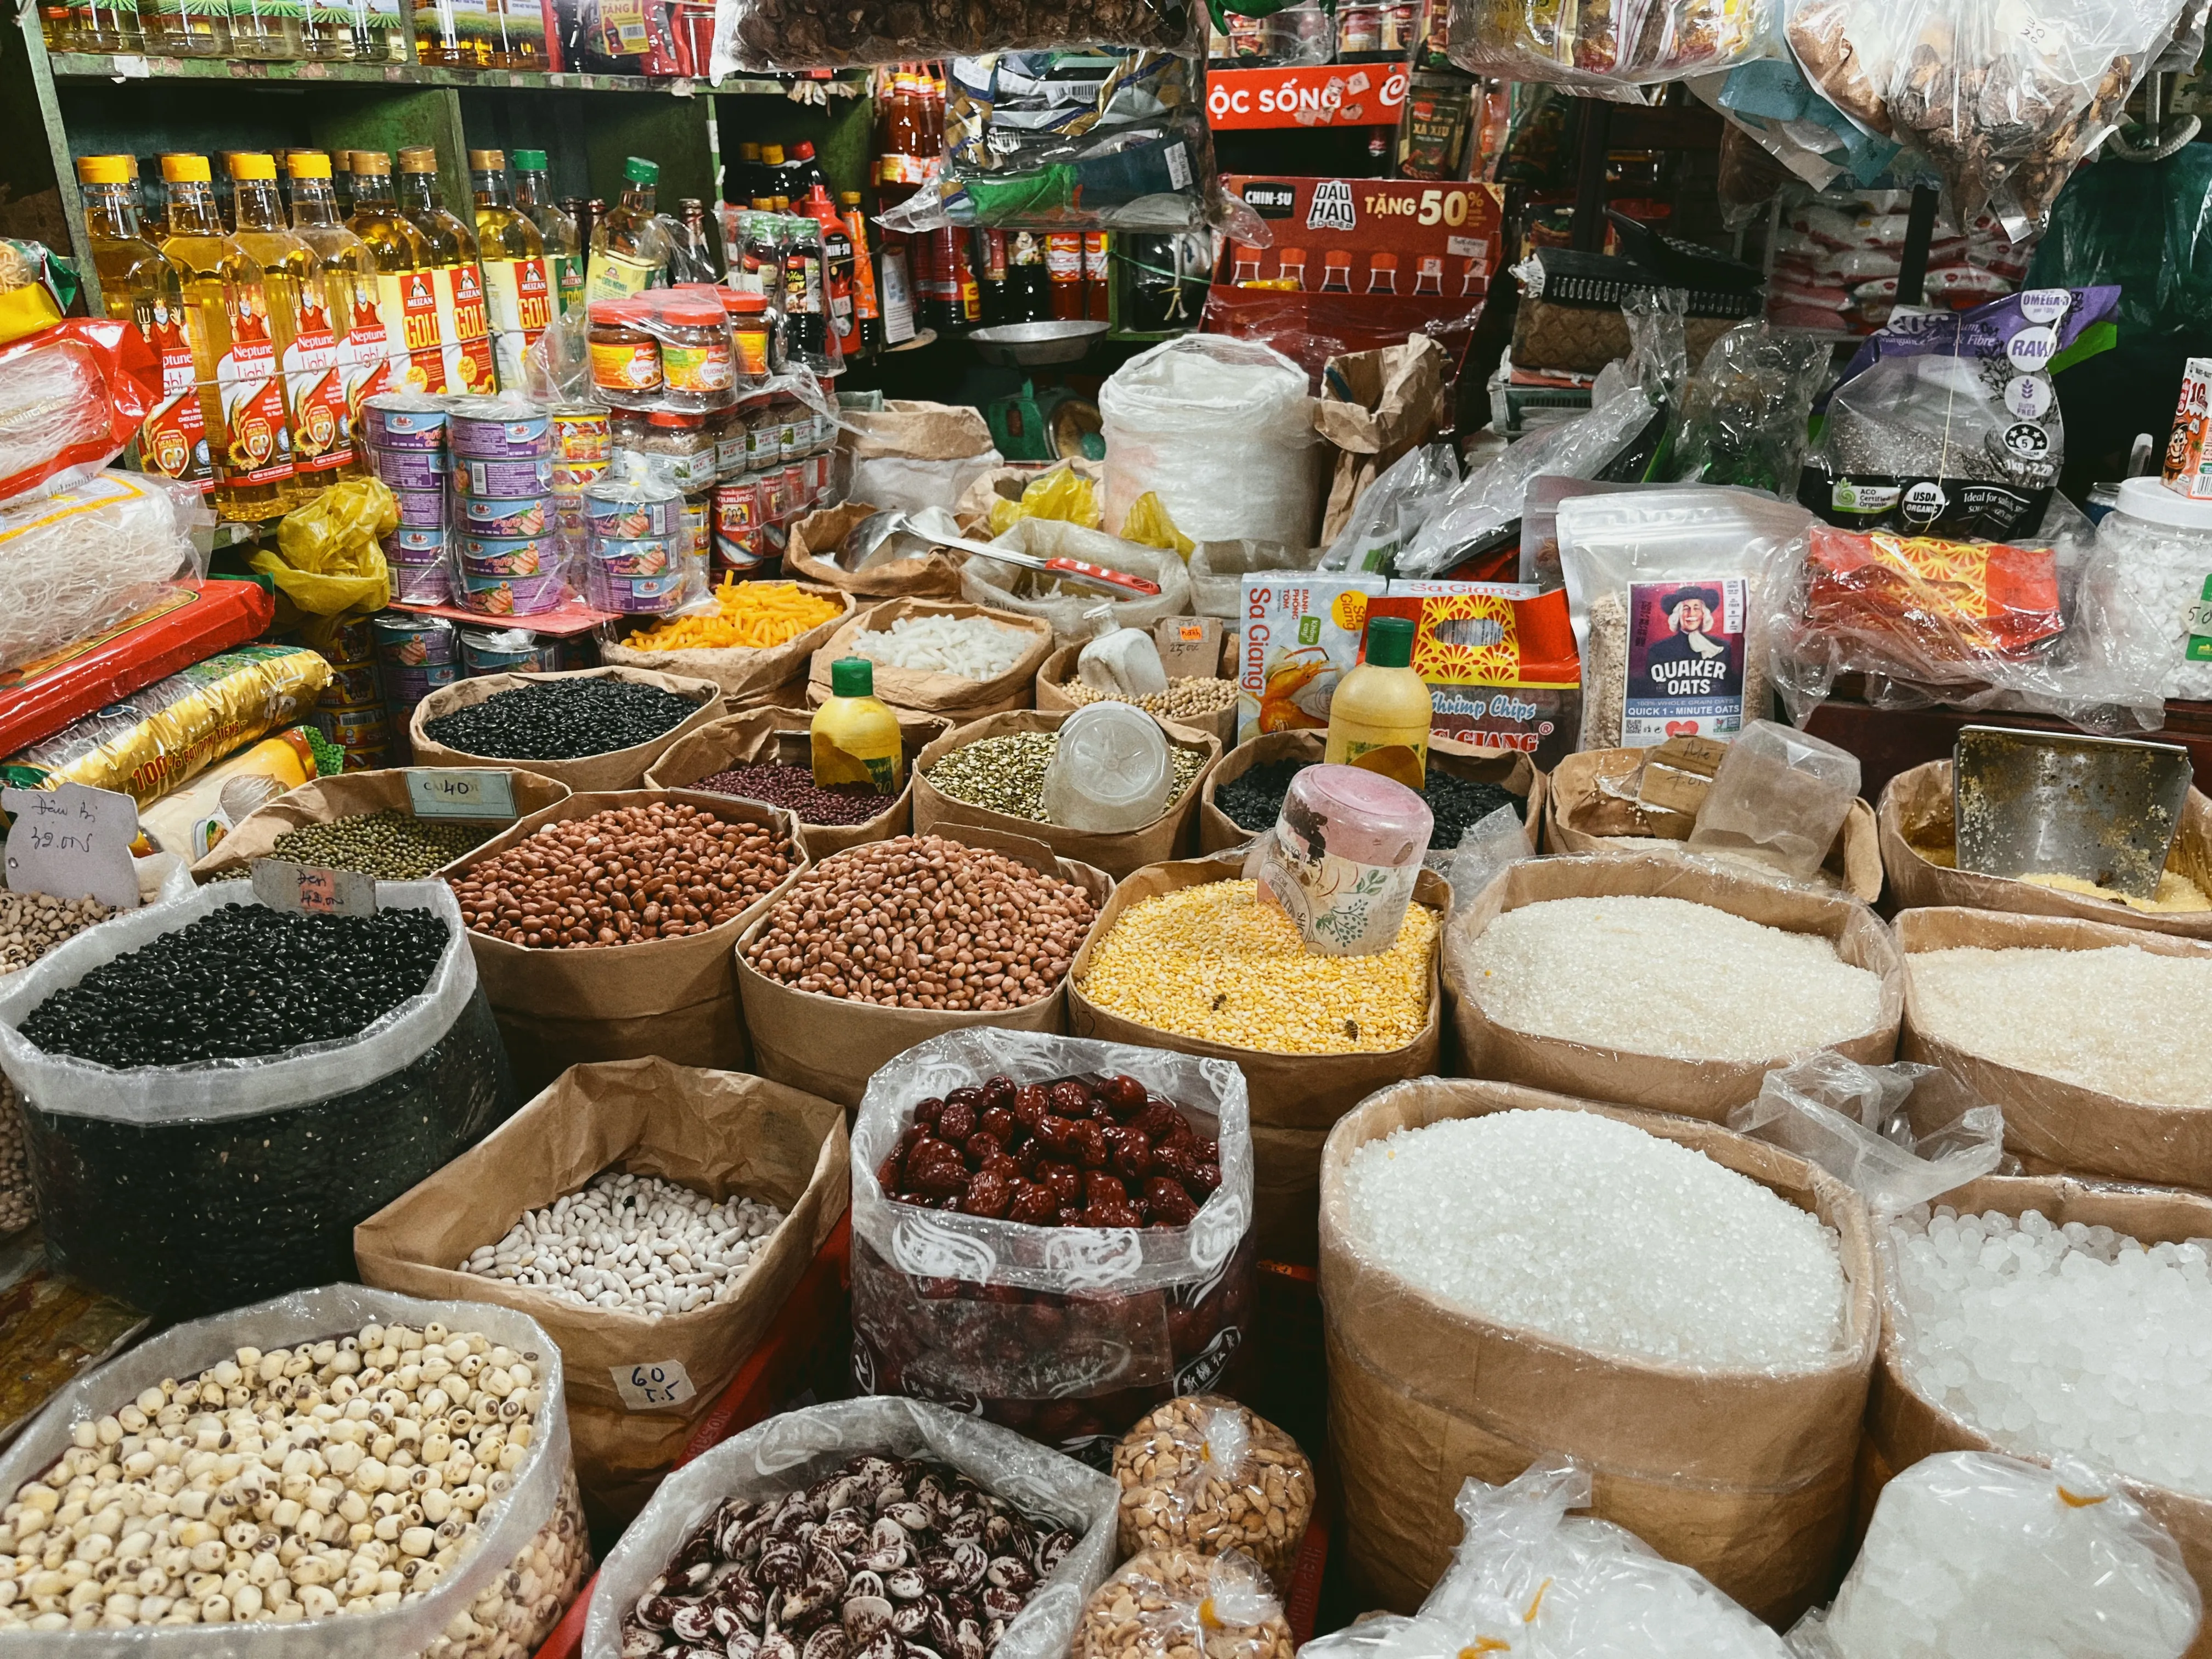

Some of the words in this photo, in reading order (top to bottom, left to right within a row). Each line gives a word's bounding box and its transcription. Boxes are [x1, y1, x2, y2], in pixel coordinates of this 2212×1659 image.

[1259, 78, 1342, 113] SỐNG
[1244, 190, 1293, 206] CHIN-SU
[1364, 193, 1417, 219] TẶNG
[1311, 198, 1353, 221] HÀO
[457, 288, 481, 300] MEIZAN
[521, 281, 546, 292] MEIZAN
[407, 296, 433, 308] MEIZAN
[297, 335, 334, 349] Neptune
[351, 329, 386, 343] Neptune
[234, 344, 273, 359] Neptune
[2012, 341, 2056, 358] RAW
[163, 353, 192, 368] ptune
[301, 351, 328, 376] Light
[237, 362, 267, 387] Light
[163, 371, 183, 397] ght
[2017, 408, 2037, 417] FREE
[2021, 439, 2028, 447] 5
[1860, 500, 1887, 509] Organic
[1913, 491, 1936, 502] USDA
[1964, 492, 1985, 503] Ideal
[1986, 492, 1997, 503] for
[1906, 503, 1938, 514] ORGANIC
[1410, 583, 1443, 592] Sa
[1453, 584, 1521, 597] Giang
[1249, 587, 1272, 620] Sa
[1282, 589, 1291, 610] TÔM
[1291, 589, 1300, 620] PHỒNG
[1301, 589, 1310, 614] BÁNH
[1340, 592, 1357, 631] Giang
[1353, 605, 1366, 624] Sa
[1306, 619, 1319, 644] Không
[1241, 624, 1271, 693] Giang
[1650, 659, 1727, 683] QUAKER
[1667, 679, 1711, 695] OATS
[1430, 690, 1486, 721] Shrimp
[1488, 694, 1537, 723] Chips
[1628, 707, 1660, 716] QUICK
[1662, 707, 1667, 716] 1
[1675, 706, 1712, 715] MINUTE
[1714, 704, 1740, 713] OATS
[1454, 730, 1539, 753] GIANG
[132, 753, 183, 792] 100%
[443, 779, 470, 795] 40
